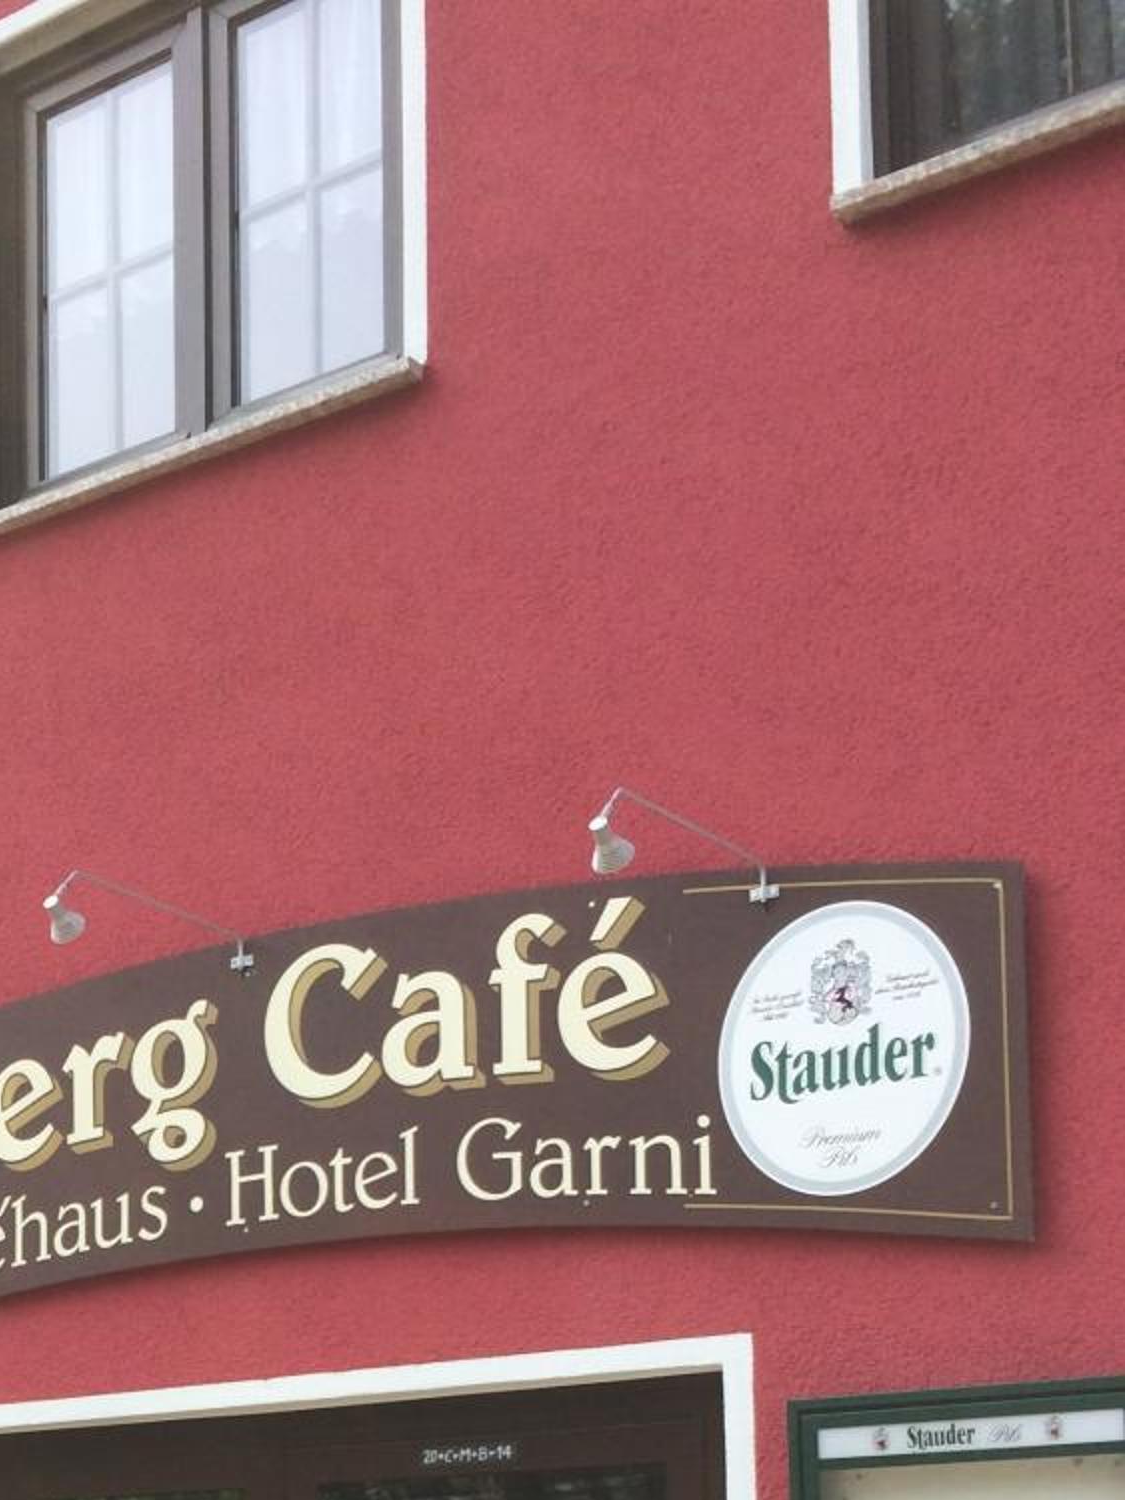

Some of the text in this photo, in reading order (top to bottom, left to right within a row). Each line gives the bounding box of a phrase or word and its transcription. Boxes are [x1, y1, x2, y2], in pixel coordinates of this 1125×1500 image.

[263, 896, 671, 1109] Café
[750, 1022, 936, 1104] Stauder
[225, 1126, 420, 1227] Hotel
[456, 1115, 718, 1200] Garni
[906, 1422, 976, 1449] Stauder
